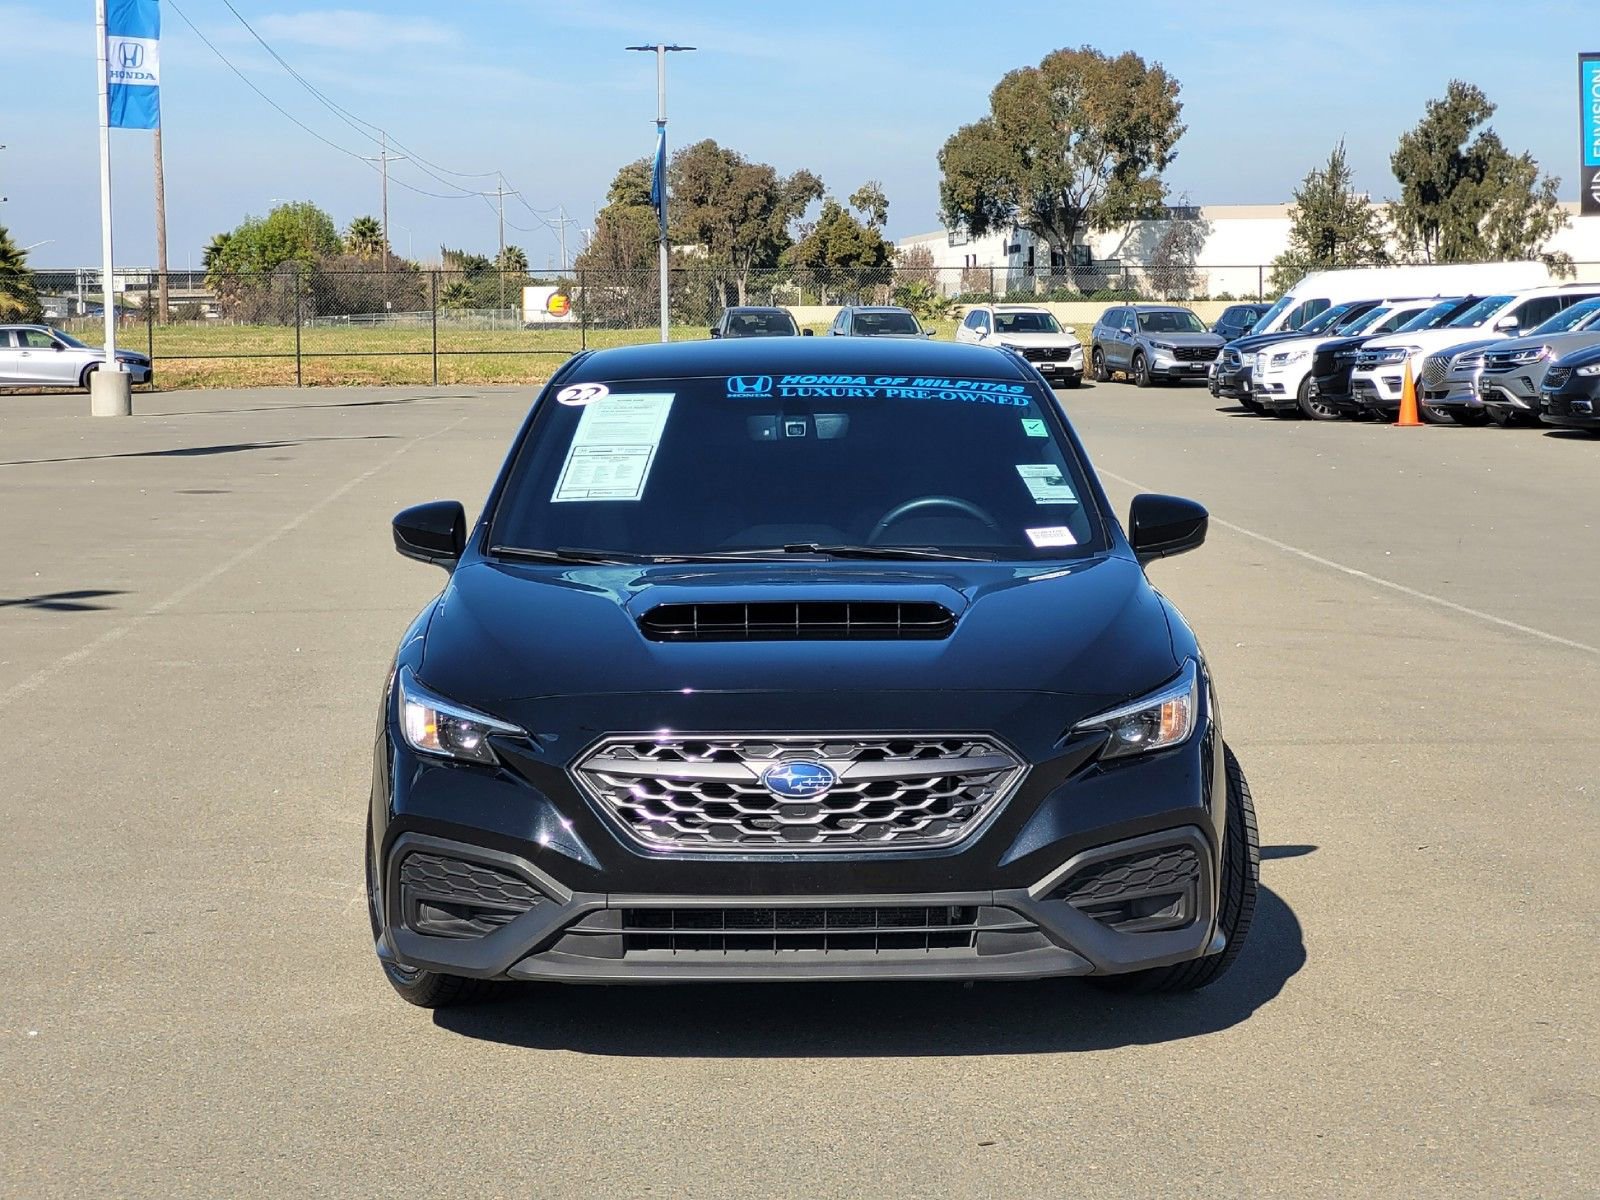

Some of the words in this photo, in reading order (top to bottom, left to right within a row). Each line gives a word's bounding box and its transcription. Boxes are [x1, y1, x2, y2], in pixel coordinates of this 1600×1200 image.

[110, 70, 156, 81] HONDA
[780, 375, 867, 385] HONDA
[873, 376, 909, 386] OF
[911, 378, 1025, 394] MILPITAS
[780, 387, 879, 398] LUXURY
[886, 388, 1029, 407] PRE-OWNED
